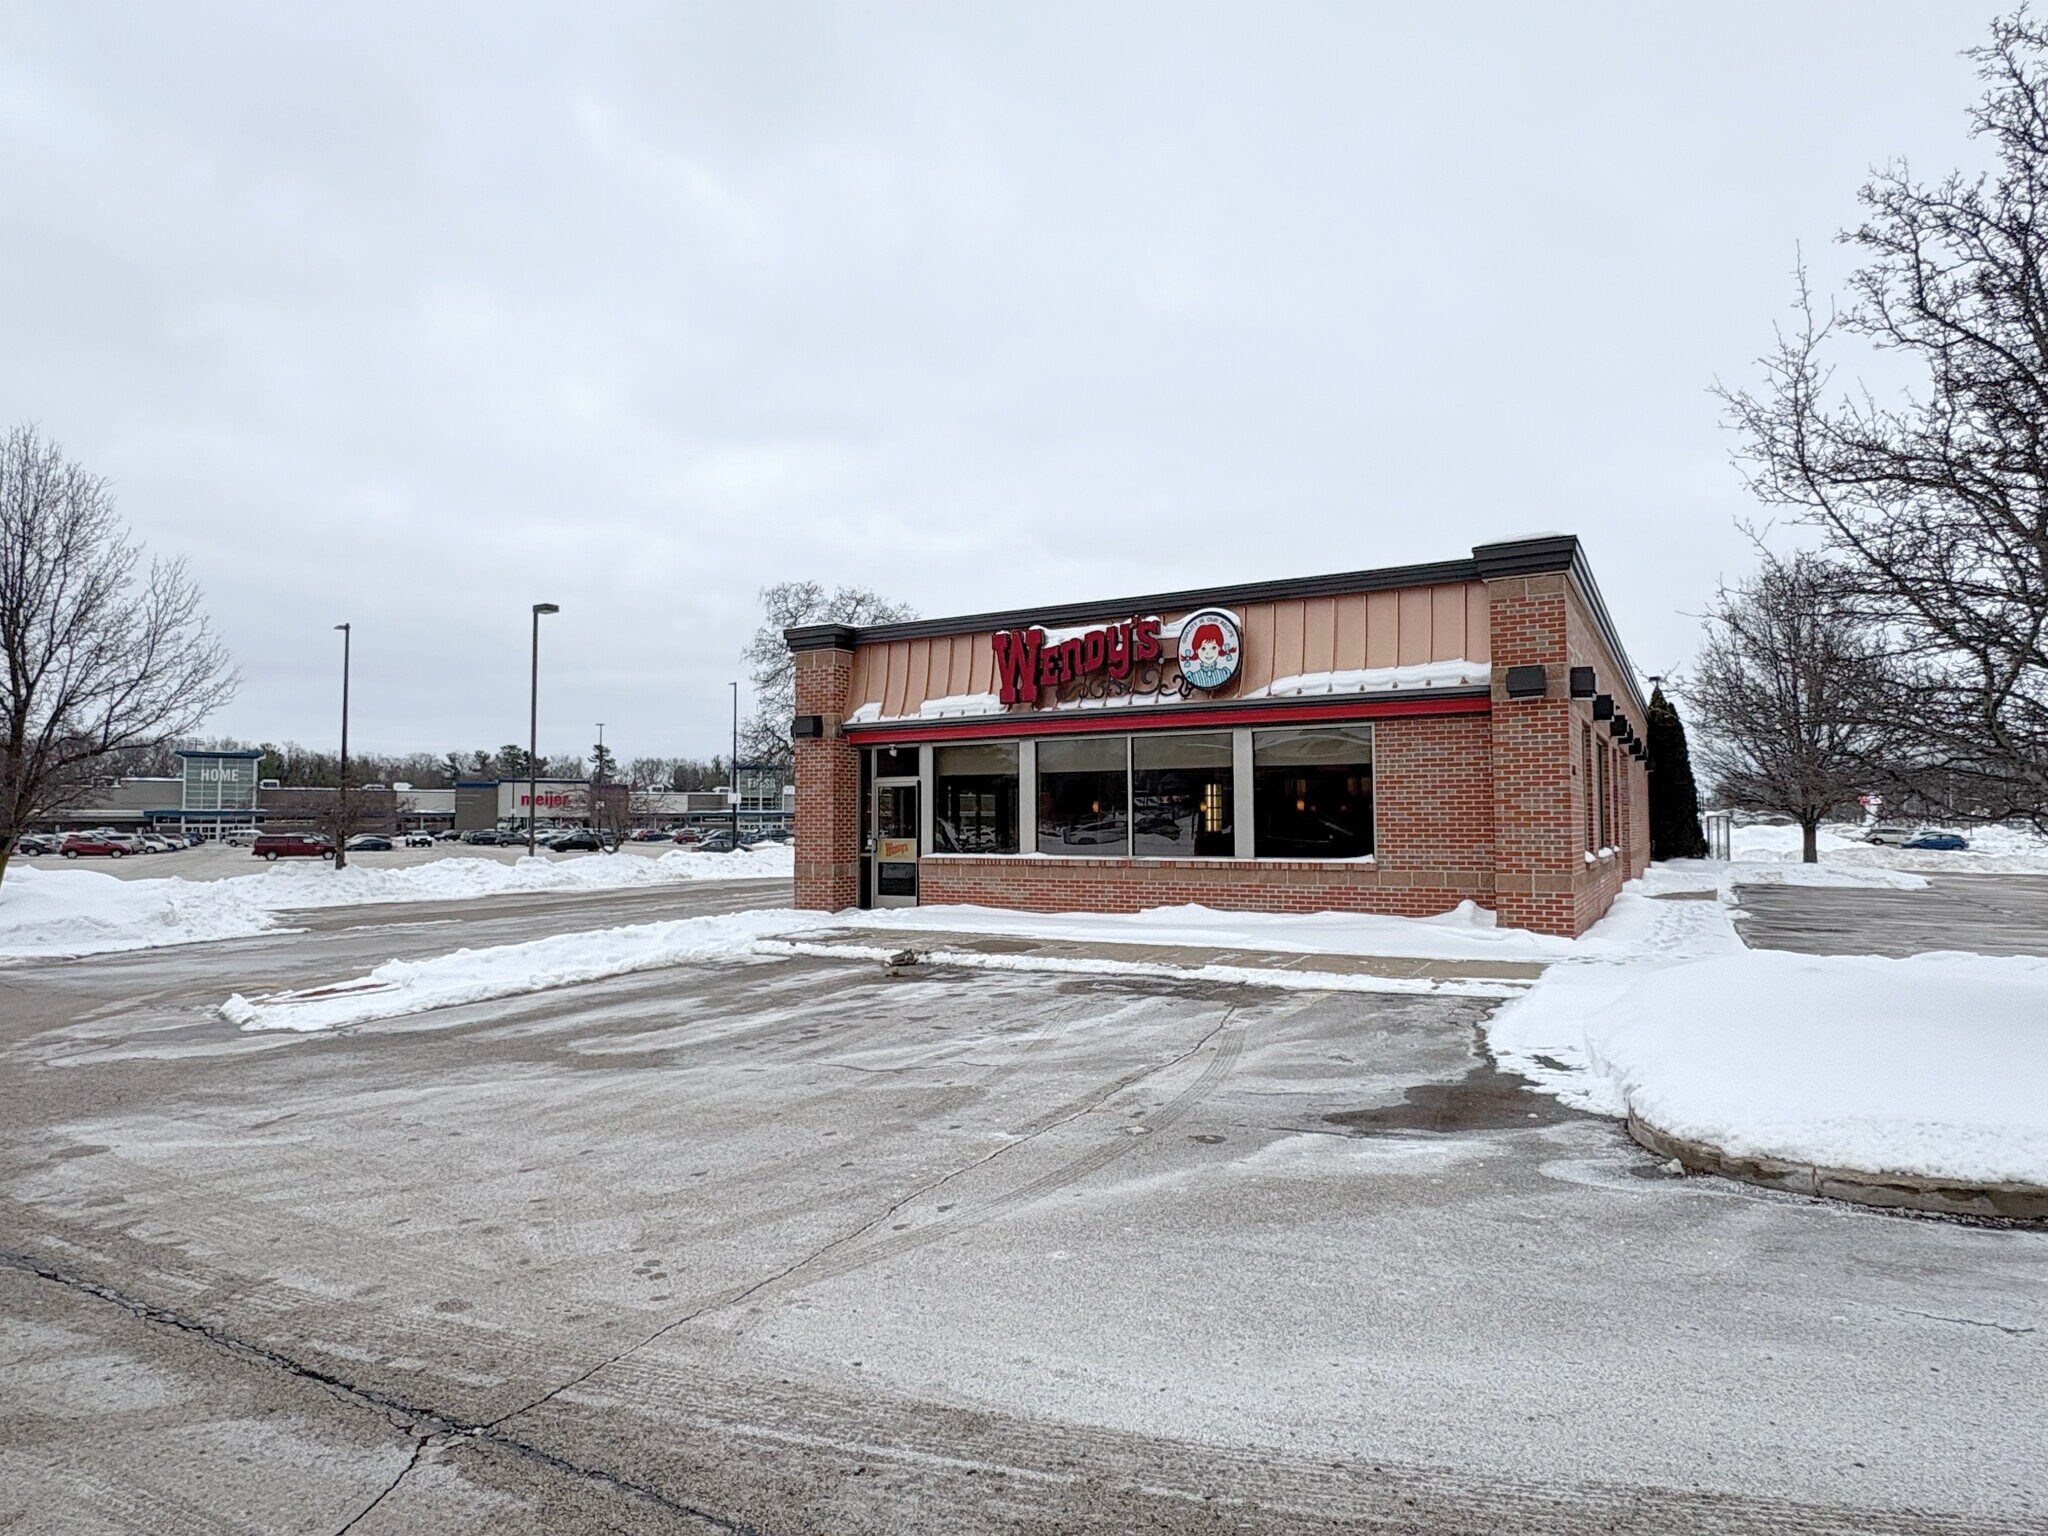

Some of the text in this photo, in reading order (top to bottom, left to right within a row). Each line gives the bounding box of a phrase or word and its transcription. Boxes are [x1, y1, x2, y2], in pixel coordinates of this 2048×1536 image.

[1182, 622, 1198, 643] QUALITY
[1220, 620, 1235, 638] RECIPE
[993, 614, 1161, 704] Wendy's
[201, 768, 239, 782] HOME
[521, 791, 569, 809] meijer
